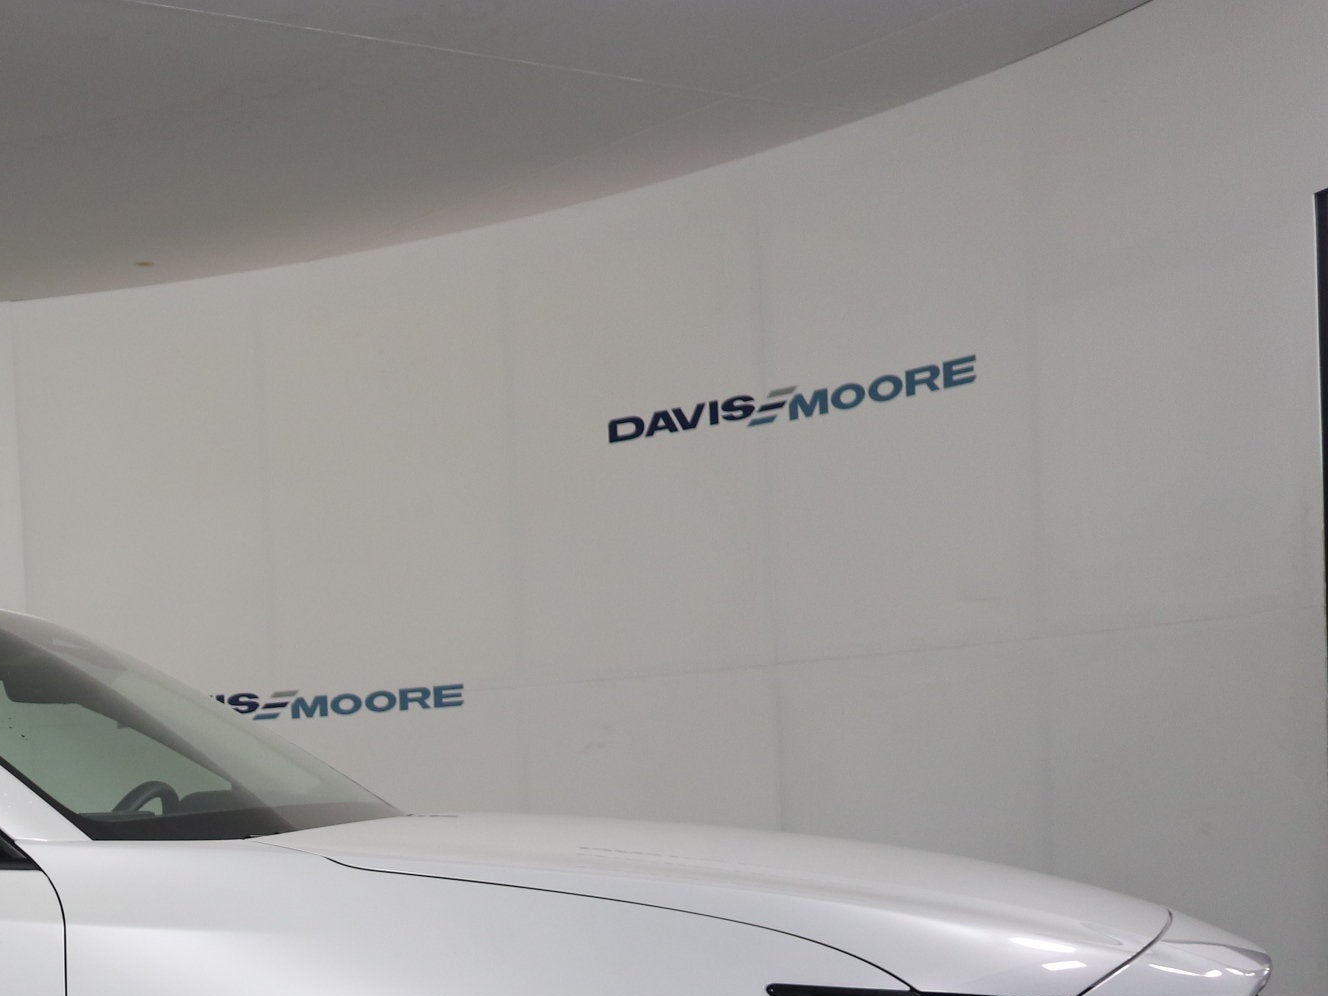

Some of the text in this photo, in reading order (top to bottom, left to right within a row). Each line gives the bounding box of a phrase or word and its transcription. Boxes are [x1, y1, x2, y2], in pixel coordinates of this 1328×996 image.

[608, 354, 977, 443] DAVIS MOORE
[291, 683, 464, 719] MOORE
